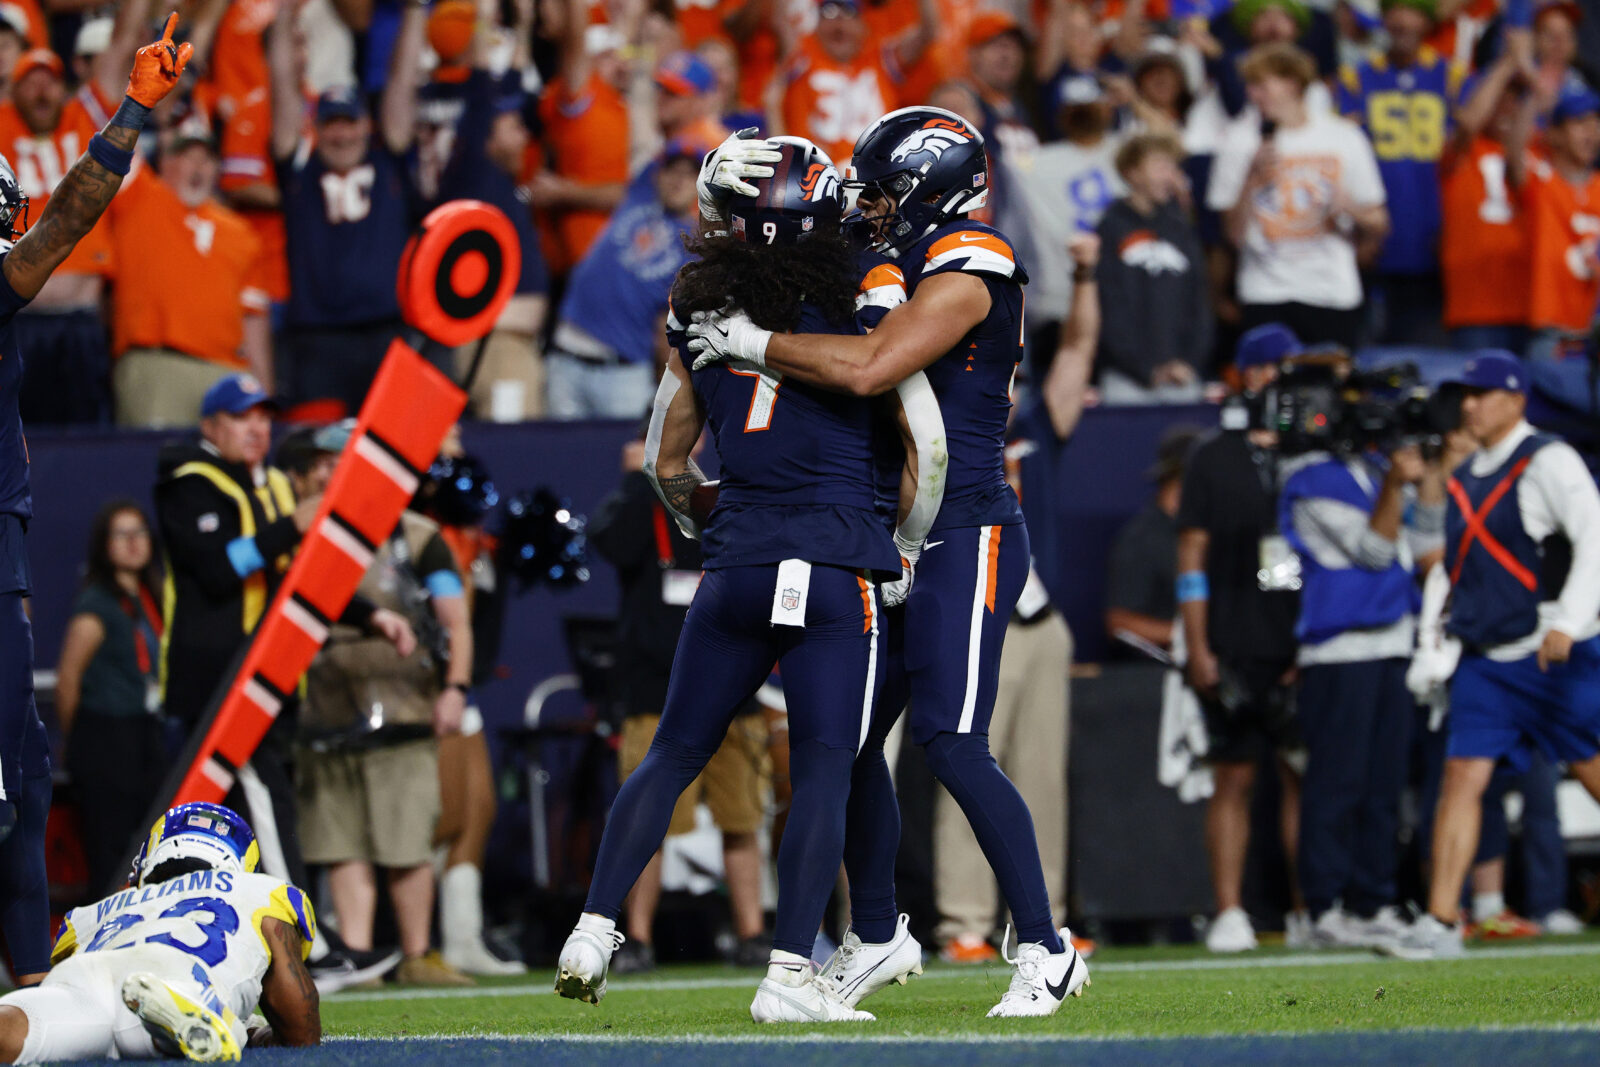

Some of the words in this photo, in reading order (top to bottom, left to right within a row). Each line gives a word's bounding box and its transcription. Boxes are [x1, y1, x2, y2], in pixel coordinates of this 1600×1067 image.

[1369, 91, 1445, 160] 58
[763, 222, 777, 245] 9
[97, 870, 234, 923] WILLIAMS
